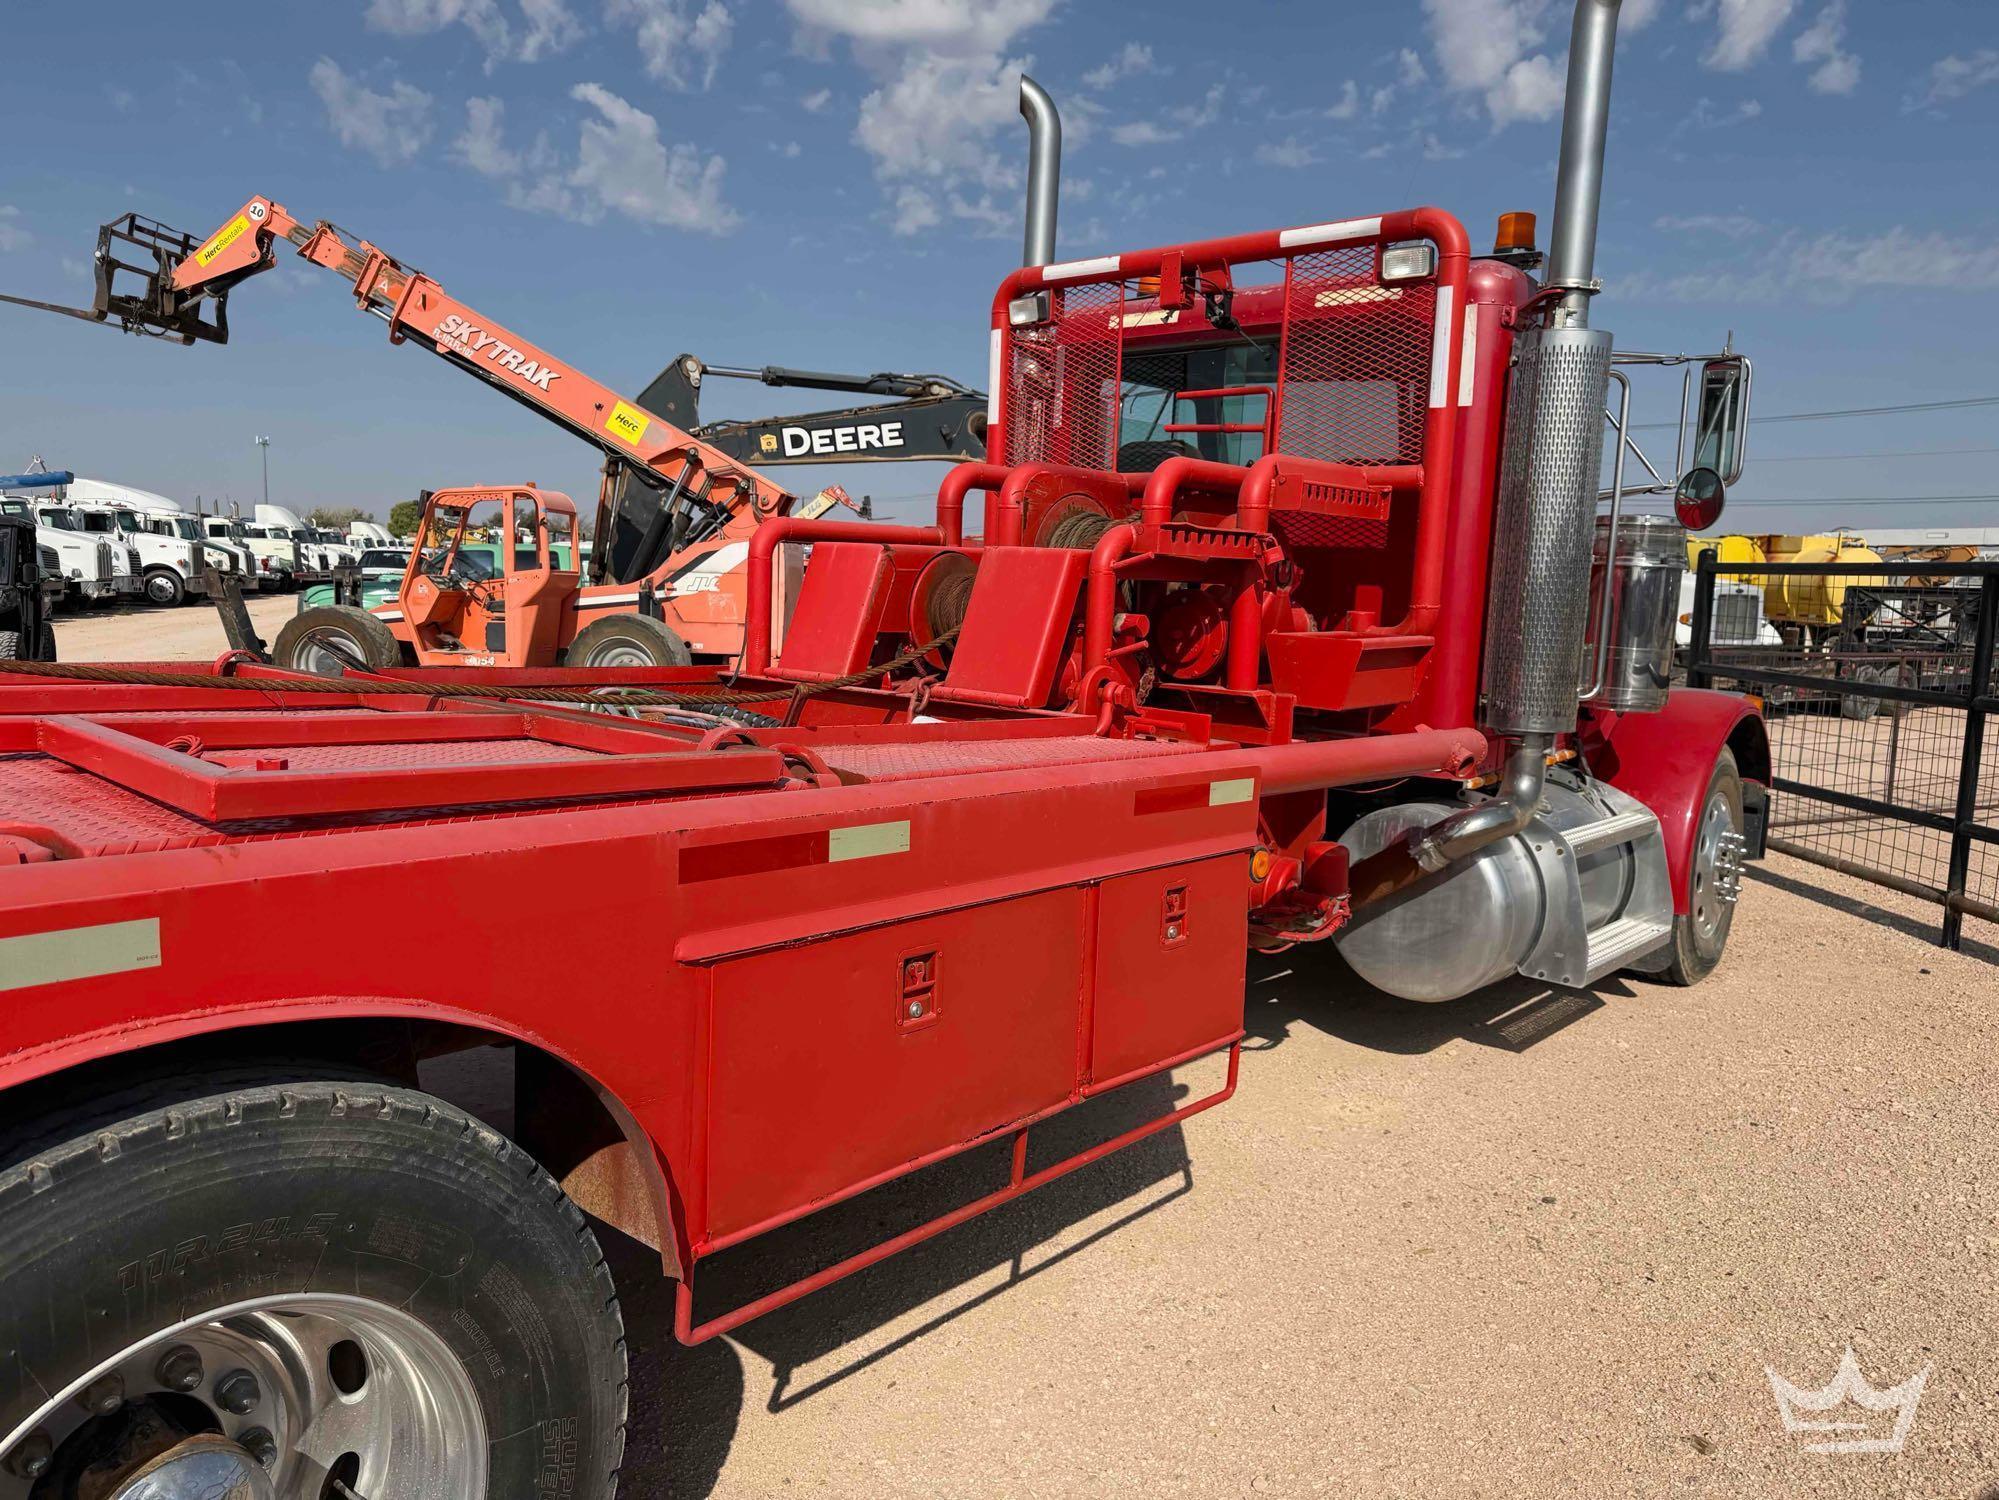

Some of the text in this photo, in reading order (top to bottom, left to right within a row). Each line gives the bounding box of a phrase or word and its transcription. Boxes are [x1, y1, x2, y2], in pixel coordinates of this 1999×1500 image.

[439, 314, 561, 392] SKYTRAK
[615, 413, 639, 432] Herc
[782, 422, 904, 457] DEERE
